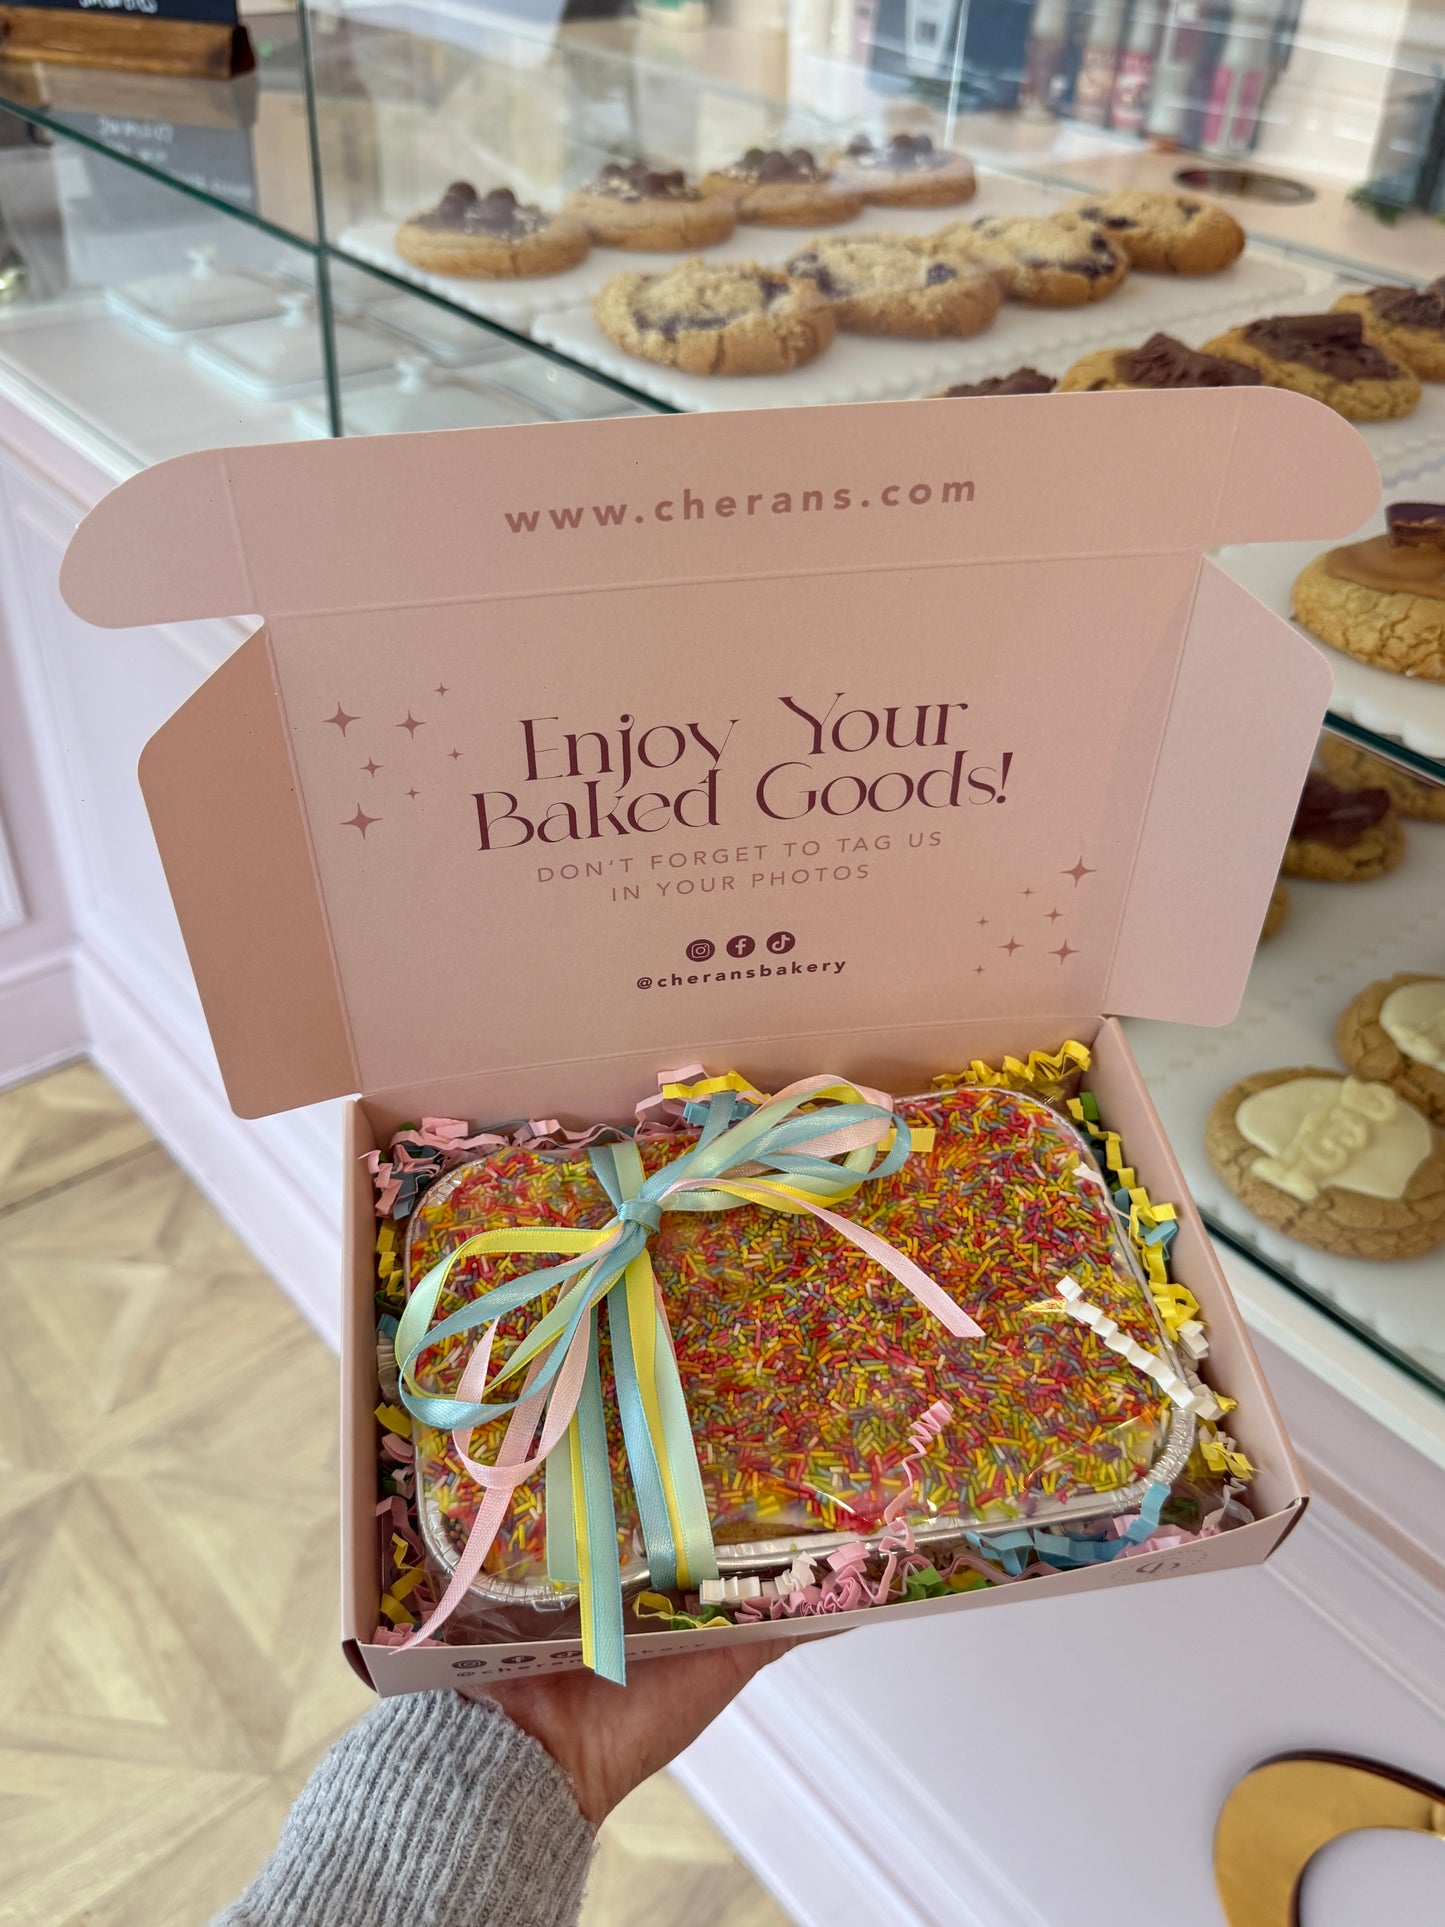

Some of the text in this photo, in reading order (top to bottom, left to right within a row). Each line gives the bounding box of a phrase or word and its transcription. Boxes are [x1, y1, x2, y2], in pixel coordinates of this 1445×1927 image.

[503, 480, 976, 534] www.cherans.com
[517, 691, 969, 793] Enjoy Your
[470, 749, 1014, 852] Baked Goods!
[537, 831, 942, 883] DON'T FORGET TO TAG US
[611, 864, 870, 902] IN YOUR PHOTOS
[636, 959, 847, 990] @cheransbakery
